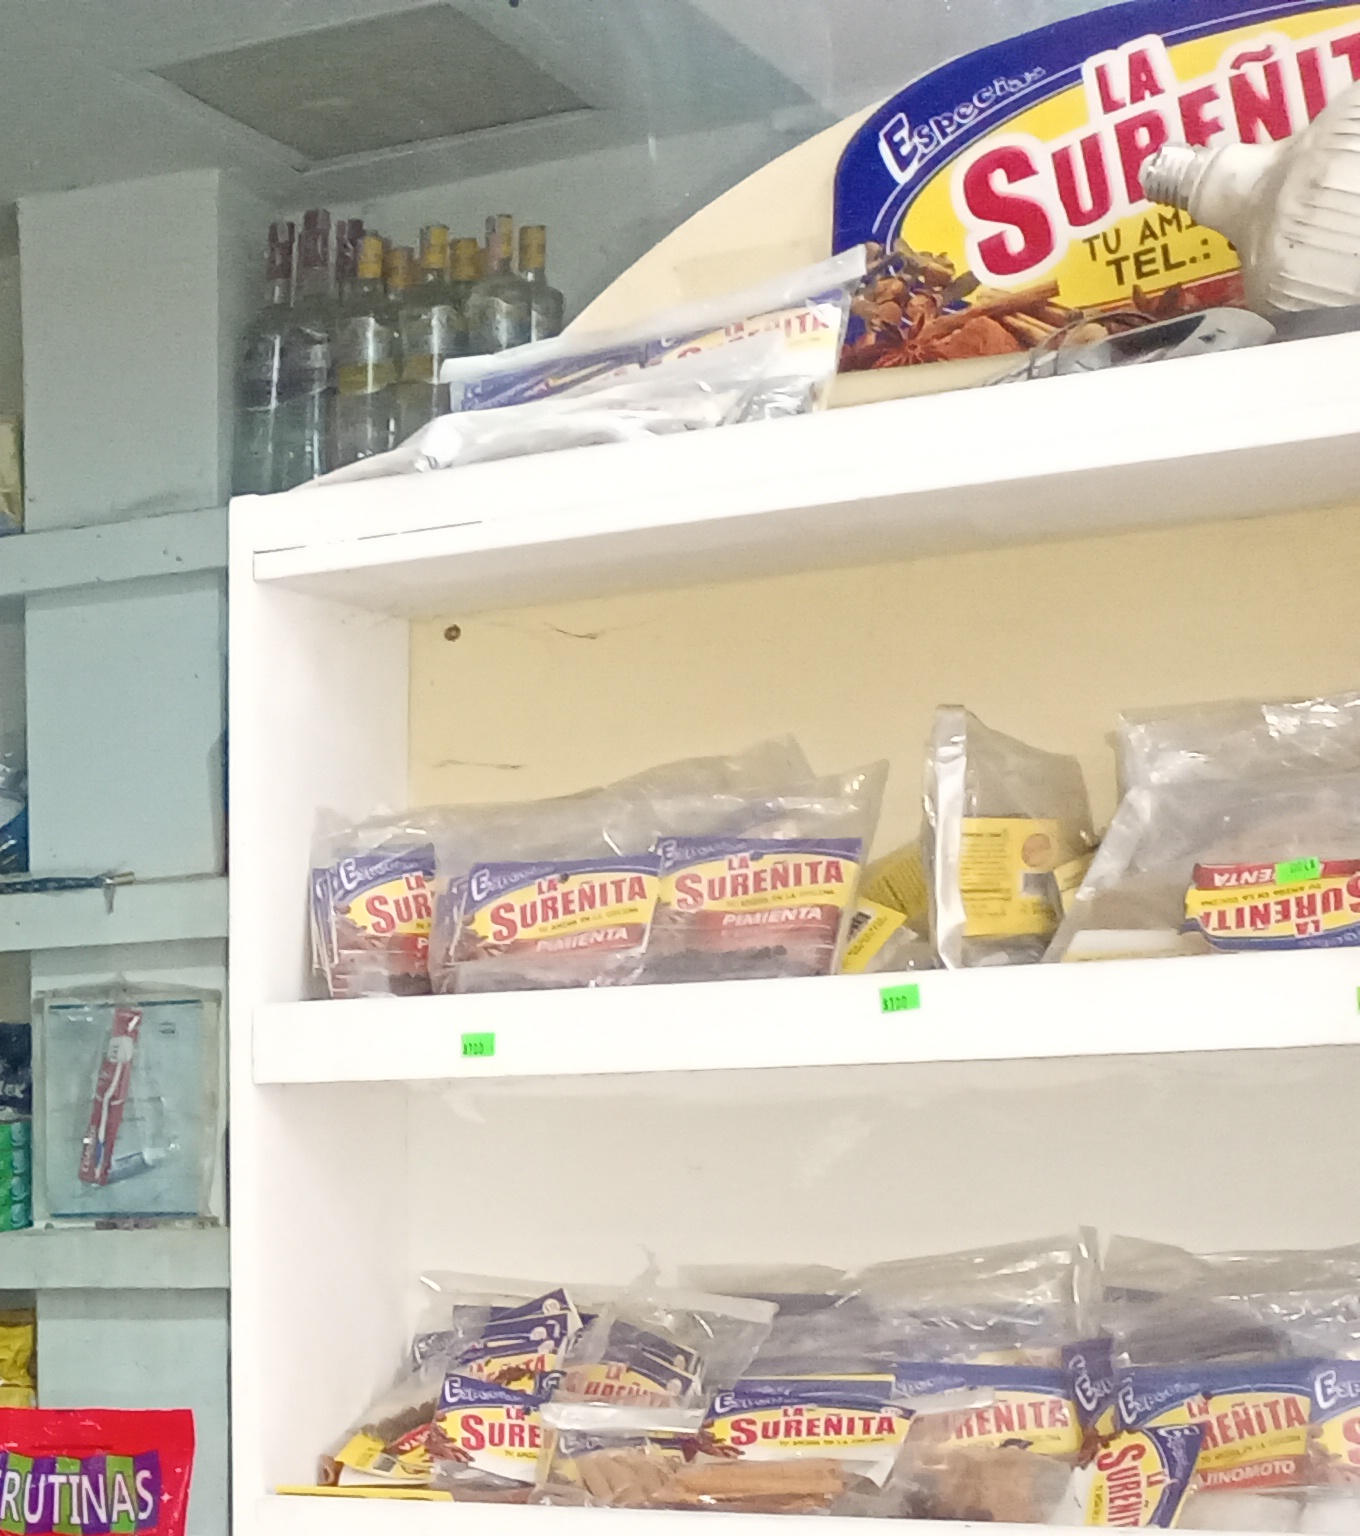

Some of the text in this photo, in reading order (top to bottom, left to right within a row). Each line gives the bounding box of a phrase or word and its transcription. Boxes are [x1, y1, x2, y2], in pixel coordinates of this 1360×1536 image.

[1096, 49, 1165, 114] LA
[1083, 230, 1121, 262] TU
[727, 856, 750, 871] LA
[405, 874, 426, 892] LA
[537, 876, 559, 894] LA
[675, 860, 844, 912] SUREÑITA
[490, 875, 648, 942] SUREÑITA
[722, 907, 822, 926] PIMIENTA
[1294, 915, 1322, 935] LA
[536, 928, 629, 953] PIMIENTA
[783, 1406, 805, 1419] LA
[730, 1411, 896, 1448] SUREÑITA
